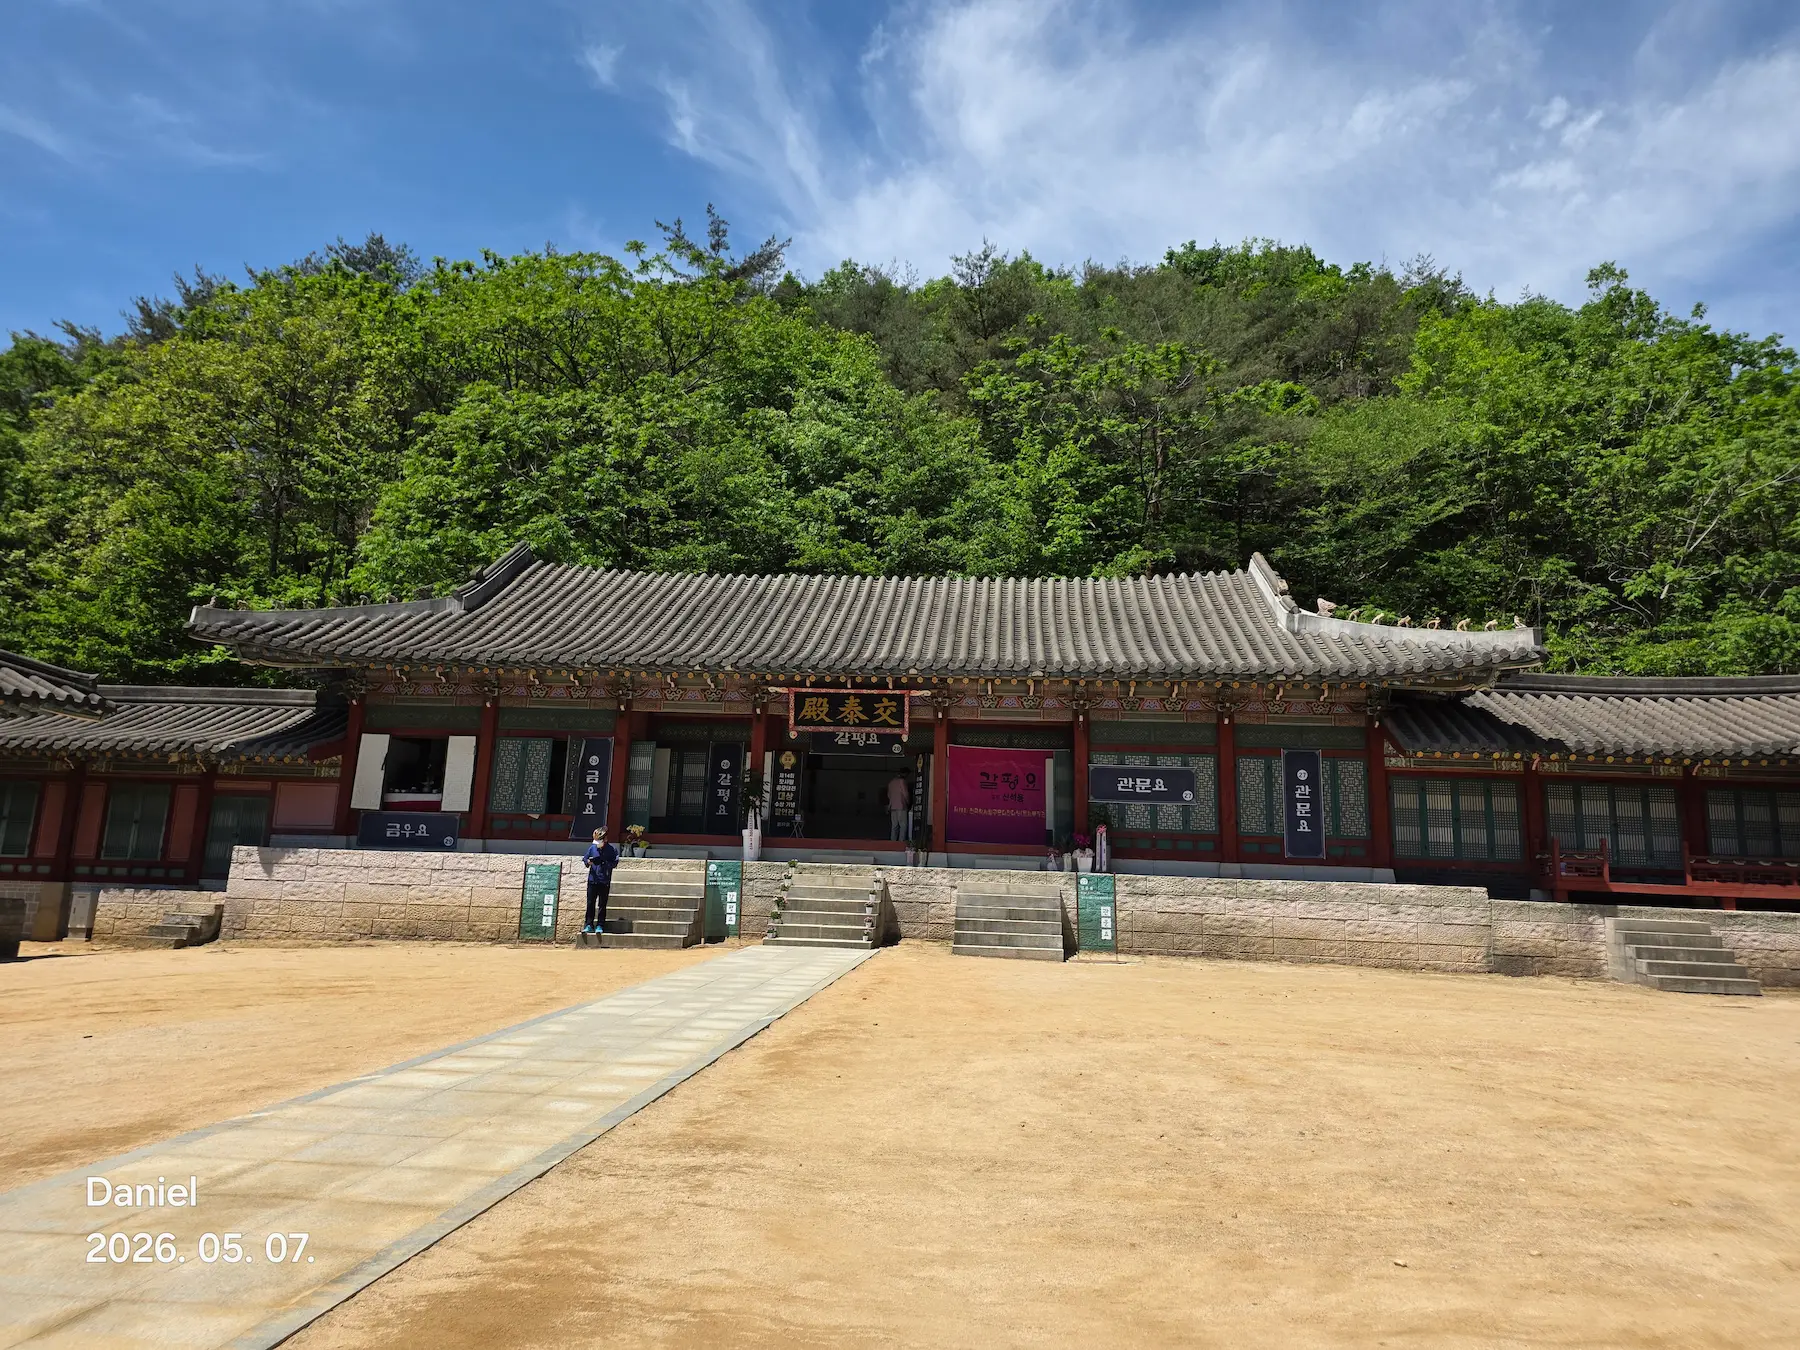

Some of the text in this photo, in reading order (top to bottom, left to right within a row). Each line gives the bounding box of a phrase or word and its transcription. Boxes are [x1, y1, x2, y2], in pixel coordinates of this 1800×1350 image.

[834, 732, 880, 747] 갈평요
[583, 770, 599, 815] 금우요
[1117, 777, 1168, 793] 관문요
[716, 773, 733, 816] 갈평요
[778, 792, 794, 801] 대상
[1295, 785, 1312, 832] 관문요
[386, 823, 430, 838] 금우요
